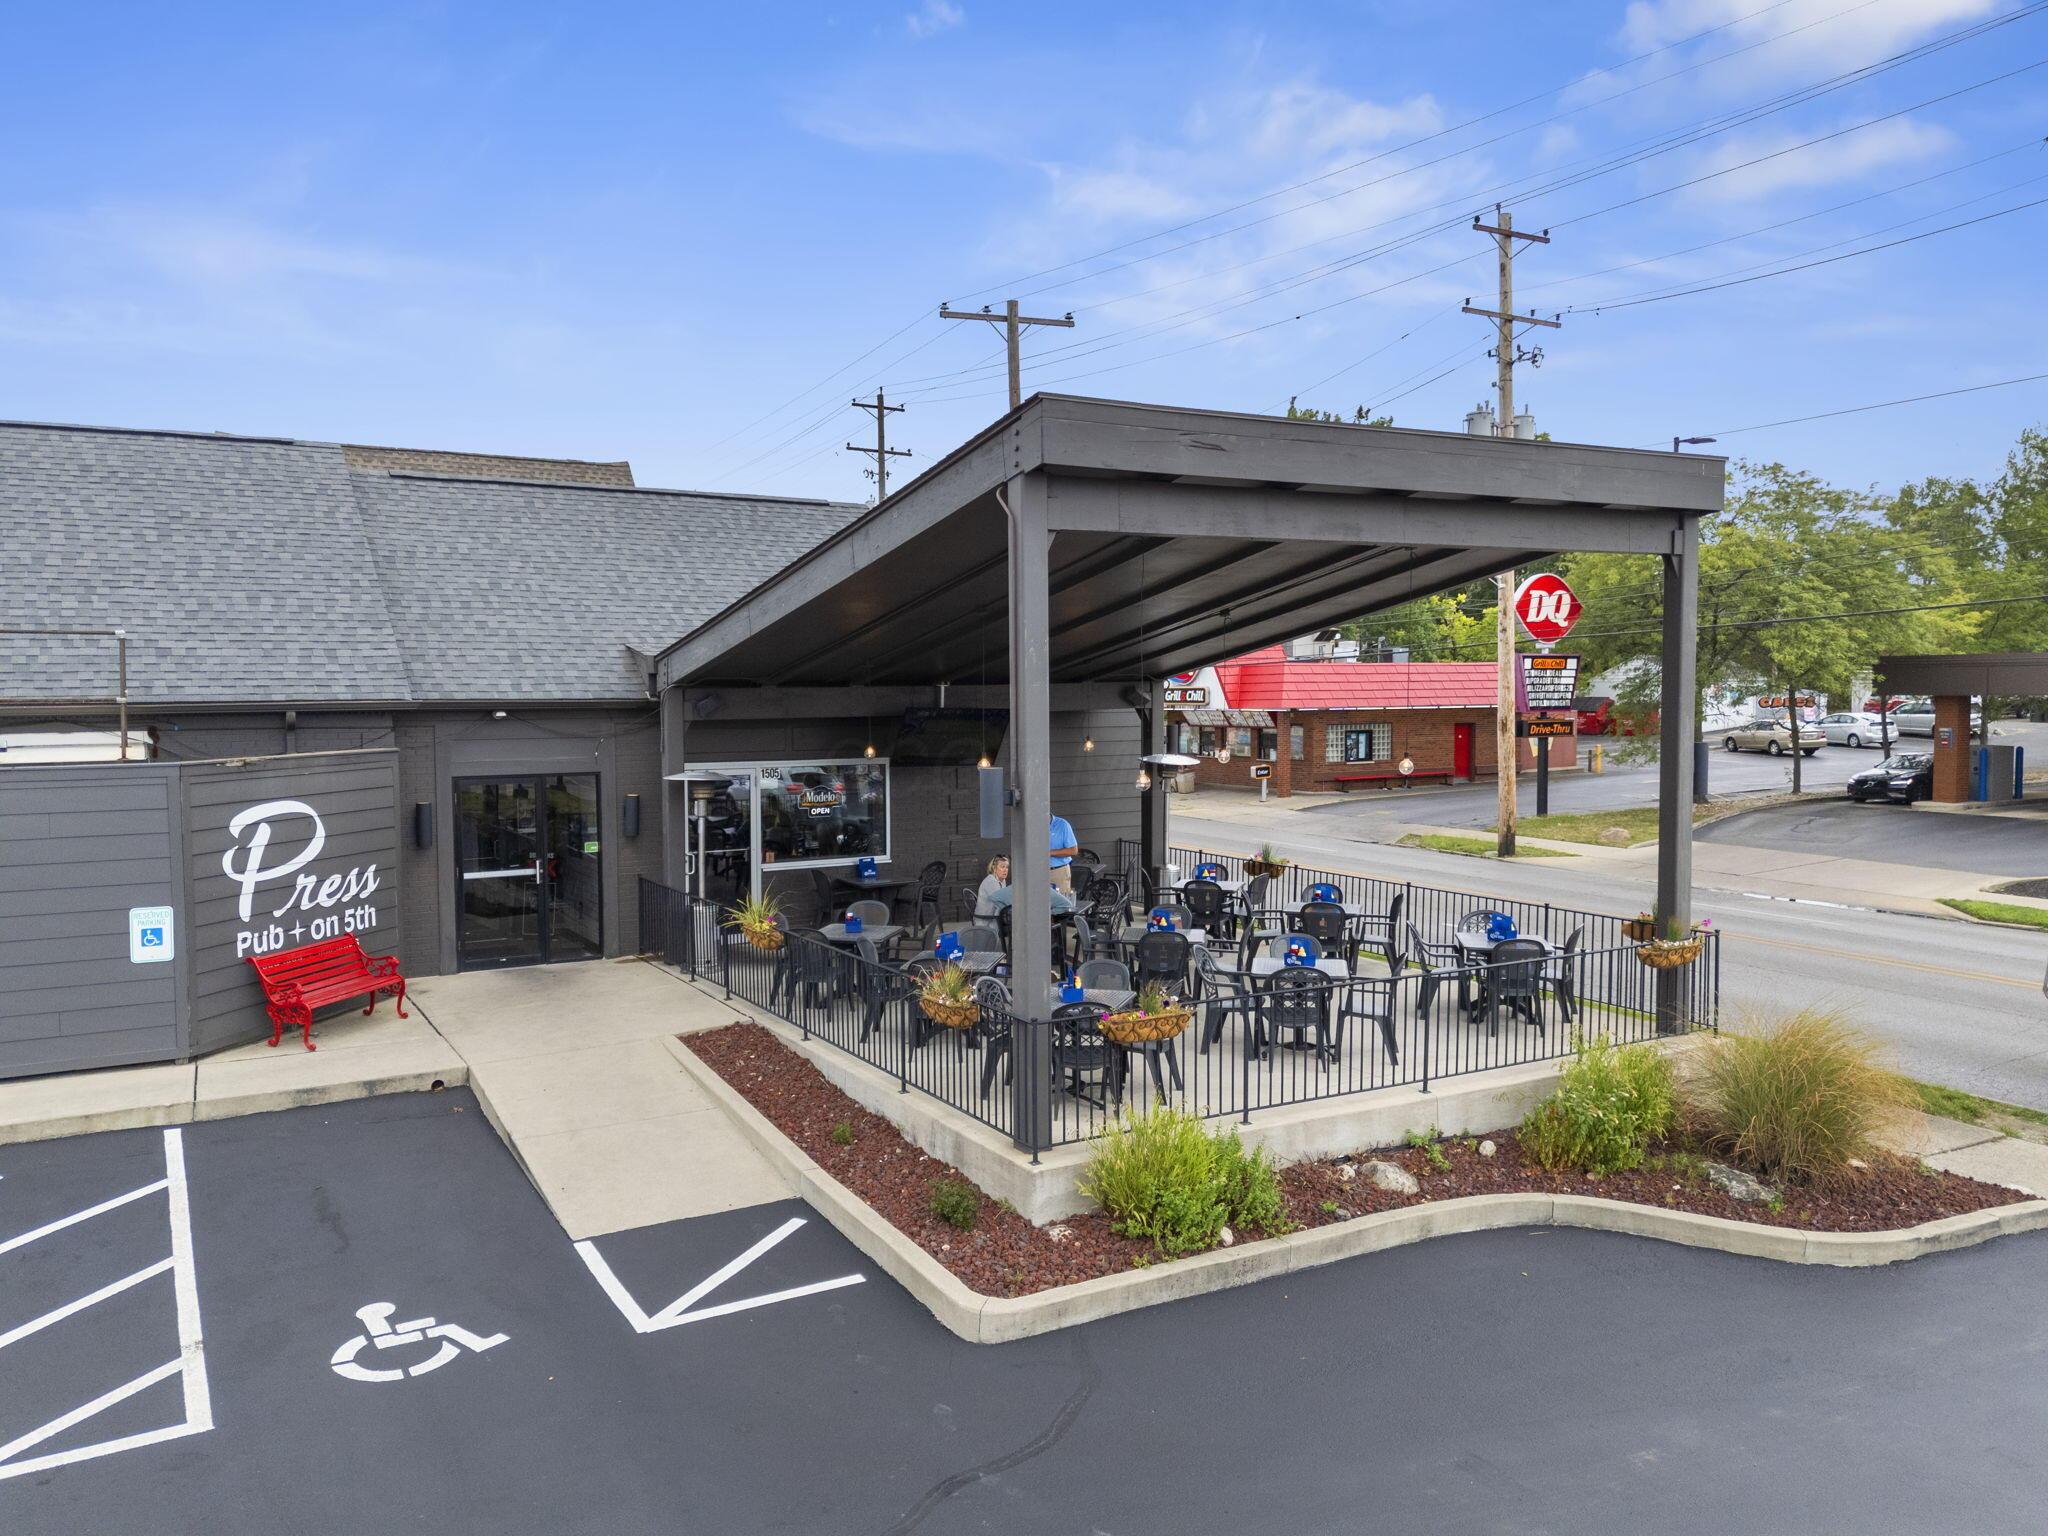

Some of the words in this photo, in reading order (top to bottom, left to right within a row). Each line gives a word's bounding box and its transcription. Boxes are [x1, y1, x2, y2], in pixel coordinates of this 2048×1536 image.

[1526, 589, 1571, 627] DQ
[1165, 690, 1181, 701] Grill
[1186, 690, 1204, 701] Chill
[1530, 723, 1571, 734] Drive-Thru
[761, 768, 780, 779] 1505
[806, 791, 835, 802] Modelo
[810, 807, 830, 815] OPEN
[222, 800, 381, 923] Press
[133, 910, 170, 920] RESERVED
[236, 923, 285, 958] Pub
[310, 915, 339, 941] on
[344, 904, 377, 933] 5th
